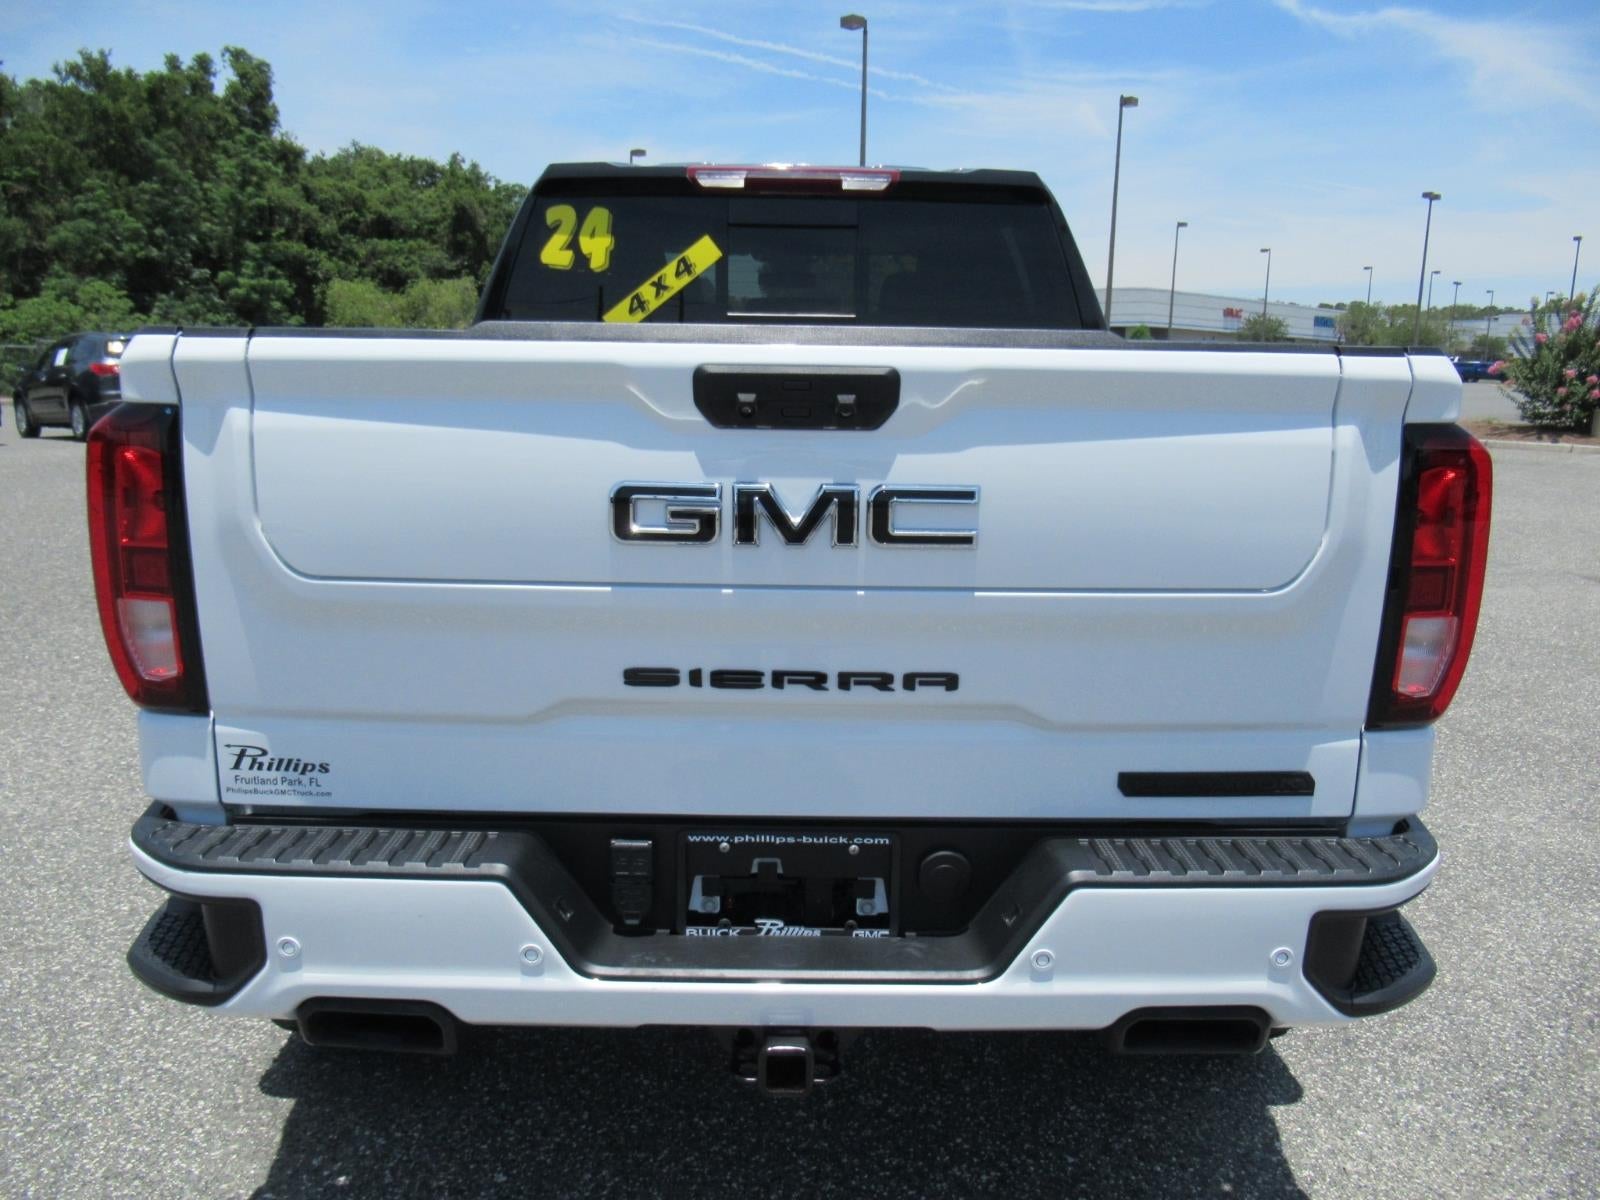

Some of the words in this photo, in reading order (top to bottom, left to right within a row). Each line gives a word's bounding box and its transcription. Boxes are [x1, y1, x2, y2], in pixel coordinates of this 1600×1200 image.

[540, 204, 614, 272] 24
[609, 481, 980, 549] GMC
[623, 667, 960, 692] SIERRA
[224, 744, 331, 776] Phillips
[234, 774, 279, 786] Fruitland
[281, 777, 307, 788] Park,
[309, 777, 322, 788] FL
[687, 833, 890, 846] www.phillips-buick.com
[685, 927, 741, 937] BUICK
[754, 918, 821, 937] Phillips
[852, 929, 890, 938] GMC
